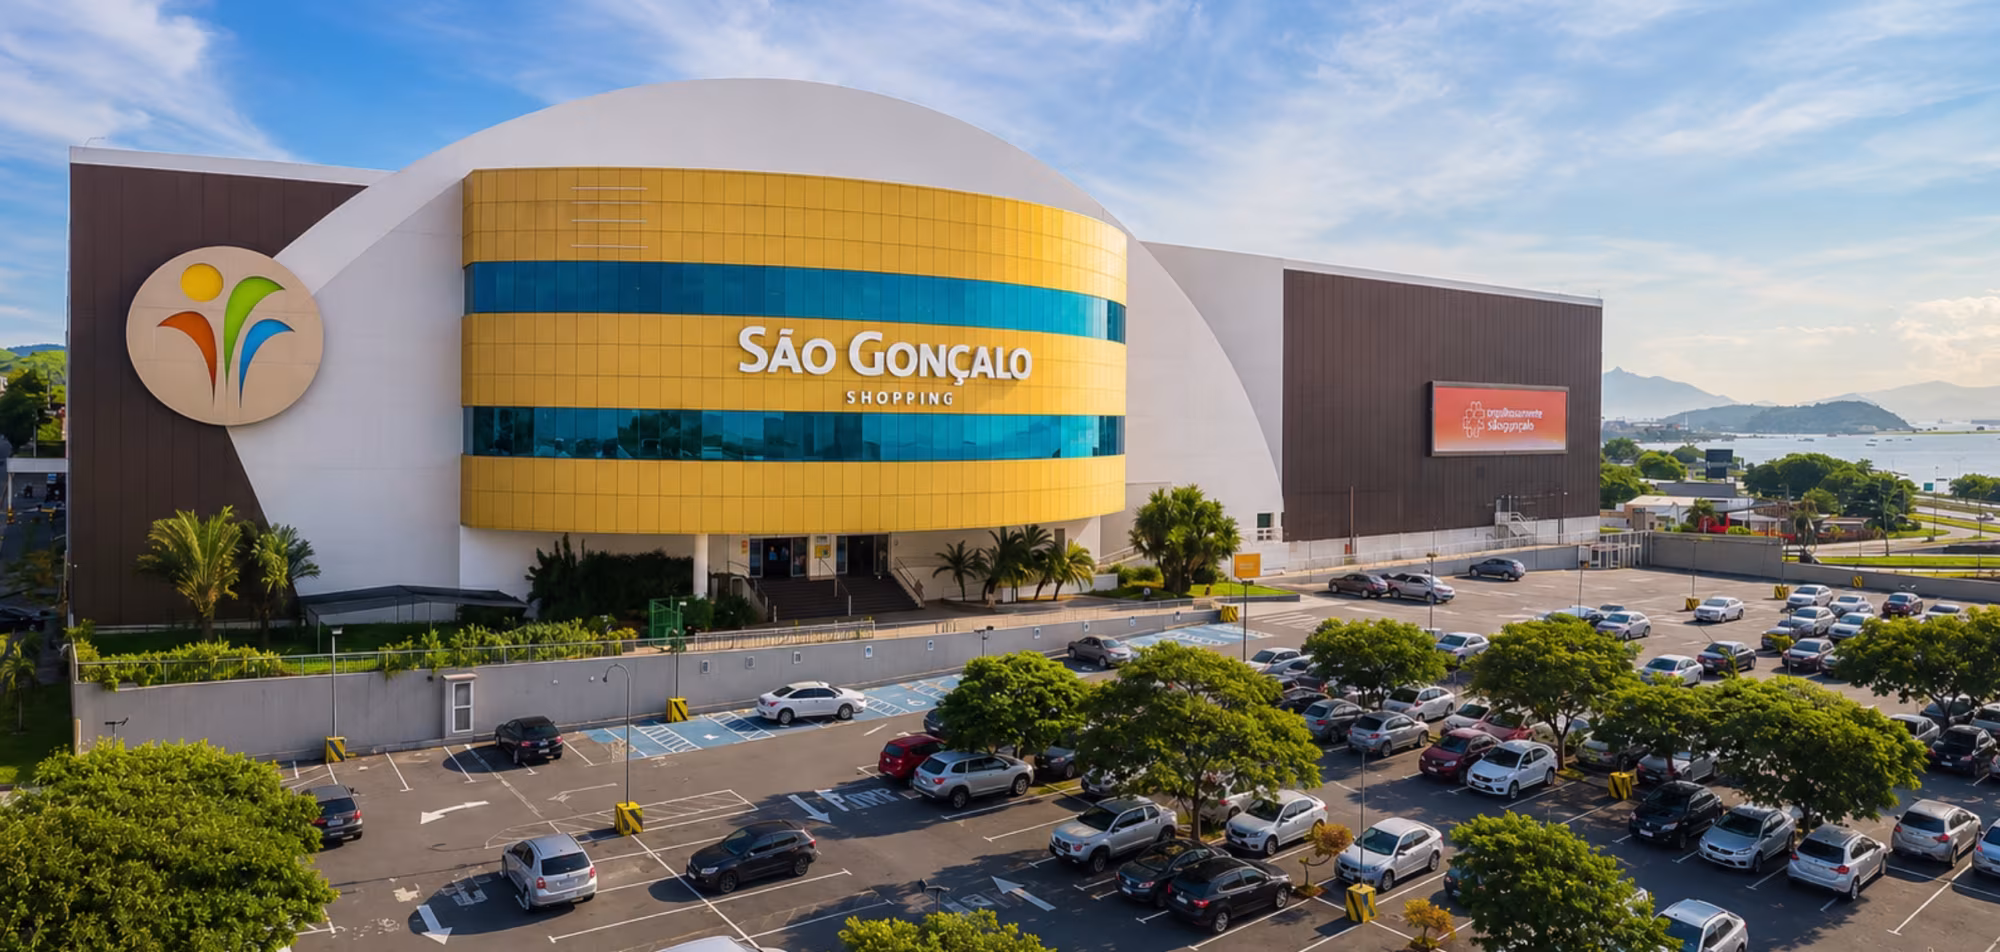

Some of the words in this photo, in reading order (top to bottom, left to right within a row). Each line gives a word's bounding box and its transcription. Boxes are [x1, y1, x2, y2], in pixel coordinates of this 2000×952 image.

[738, 325, 837, 376] SÃO
[848, 330, 1033, 386] GONÇALO
[846, 390, 954, 406] SHOPPING
